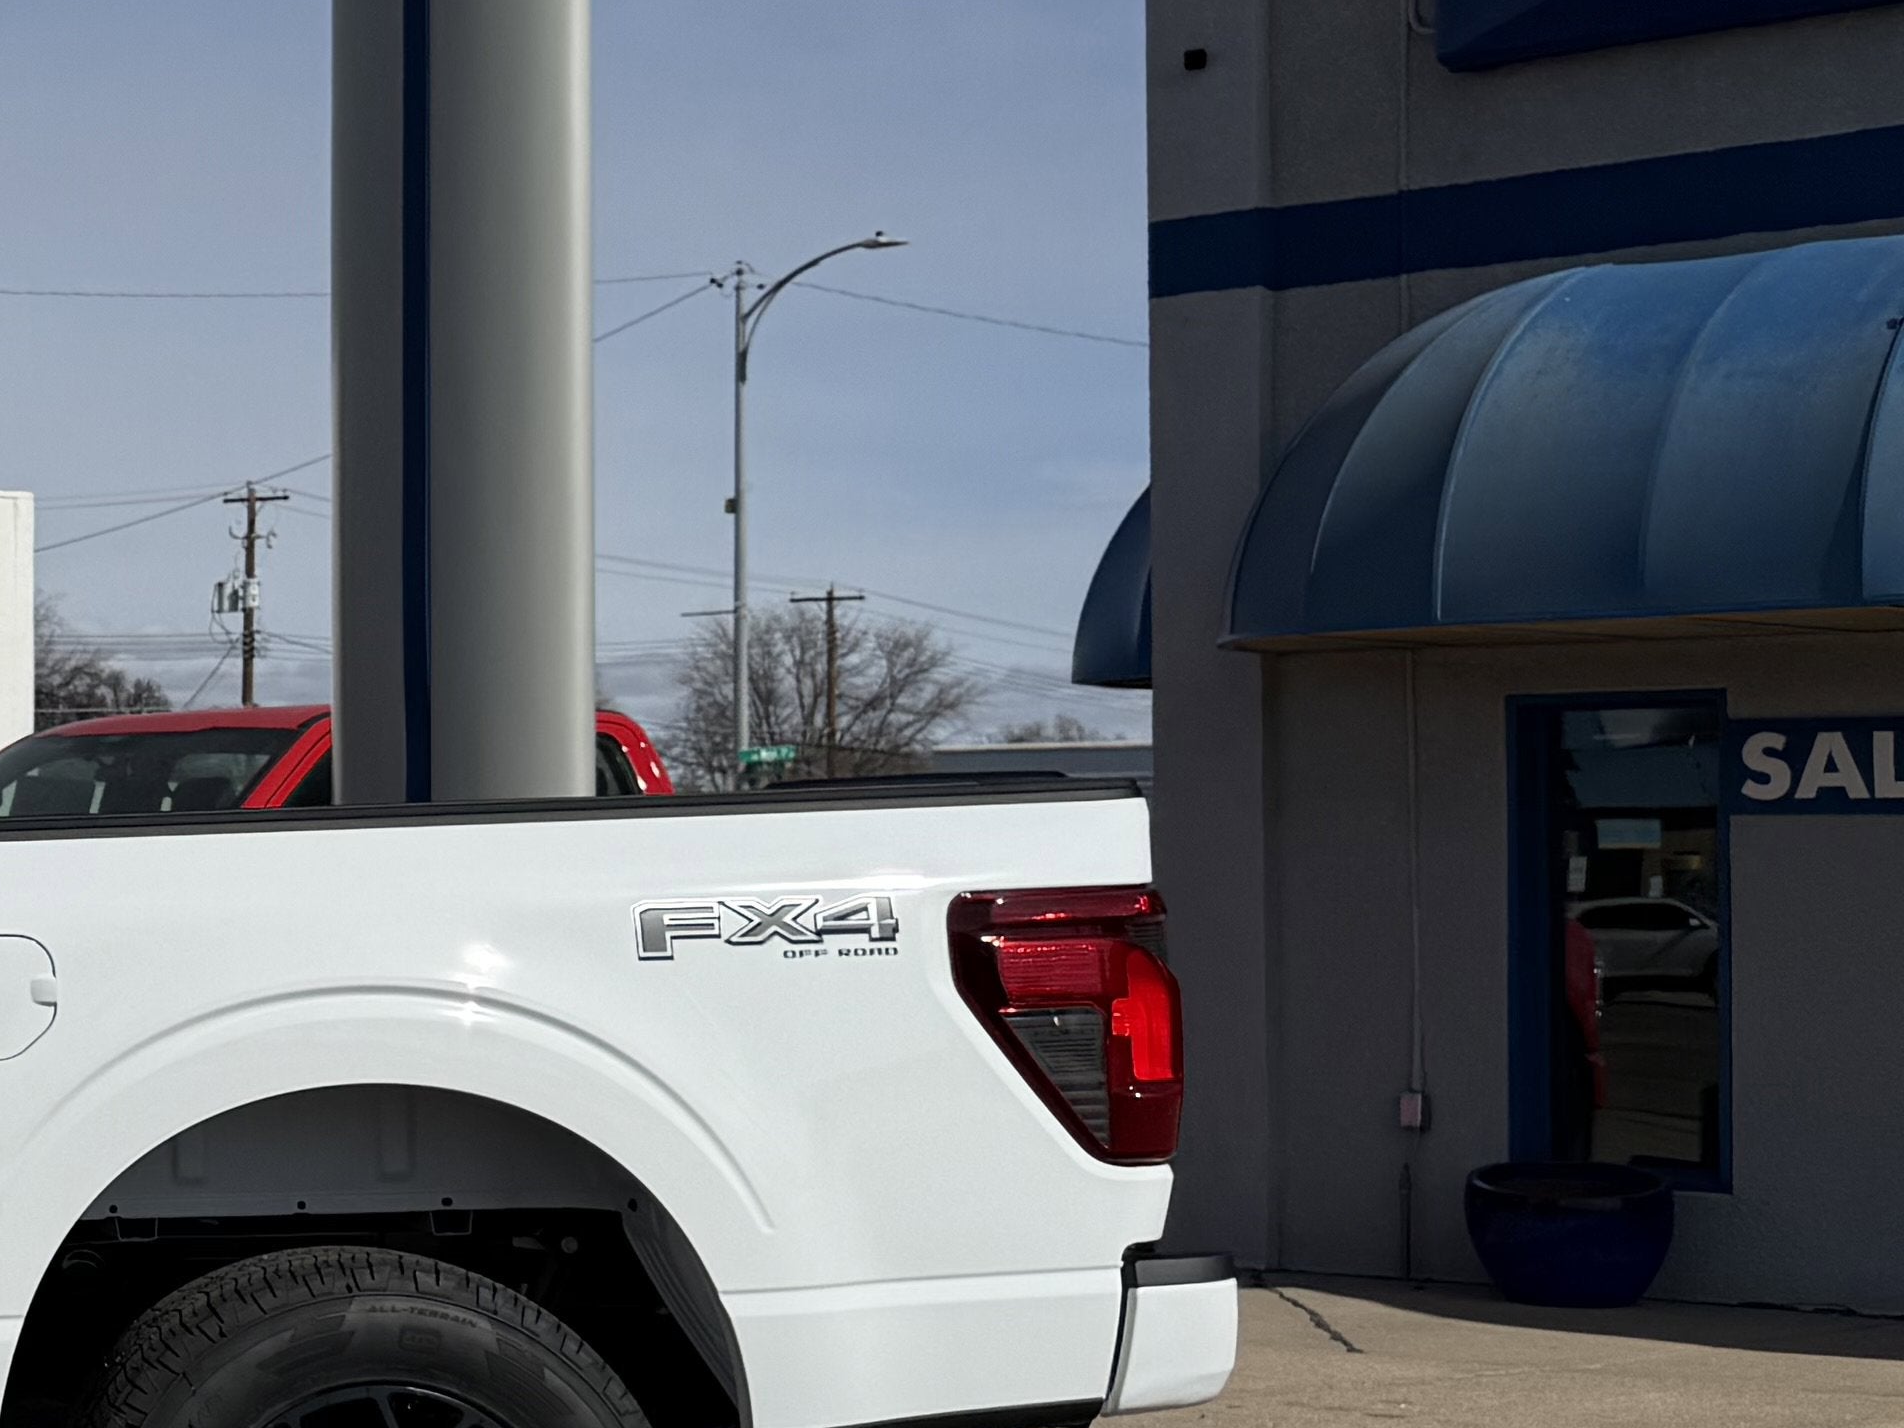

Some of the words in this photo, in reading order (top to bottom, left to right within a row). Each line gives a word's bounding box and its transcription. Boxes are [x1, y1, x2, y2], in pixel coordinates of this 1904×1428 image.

[630, 892, 900, 961] FX4
[782, 947, 829, 960] OFF
[837, 946, 900, 958] ROAD
